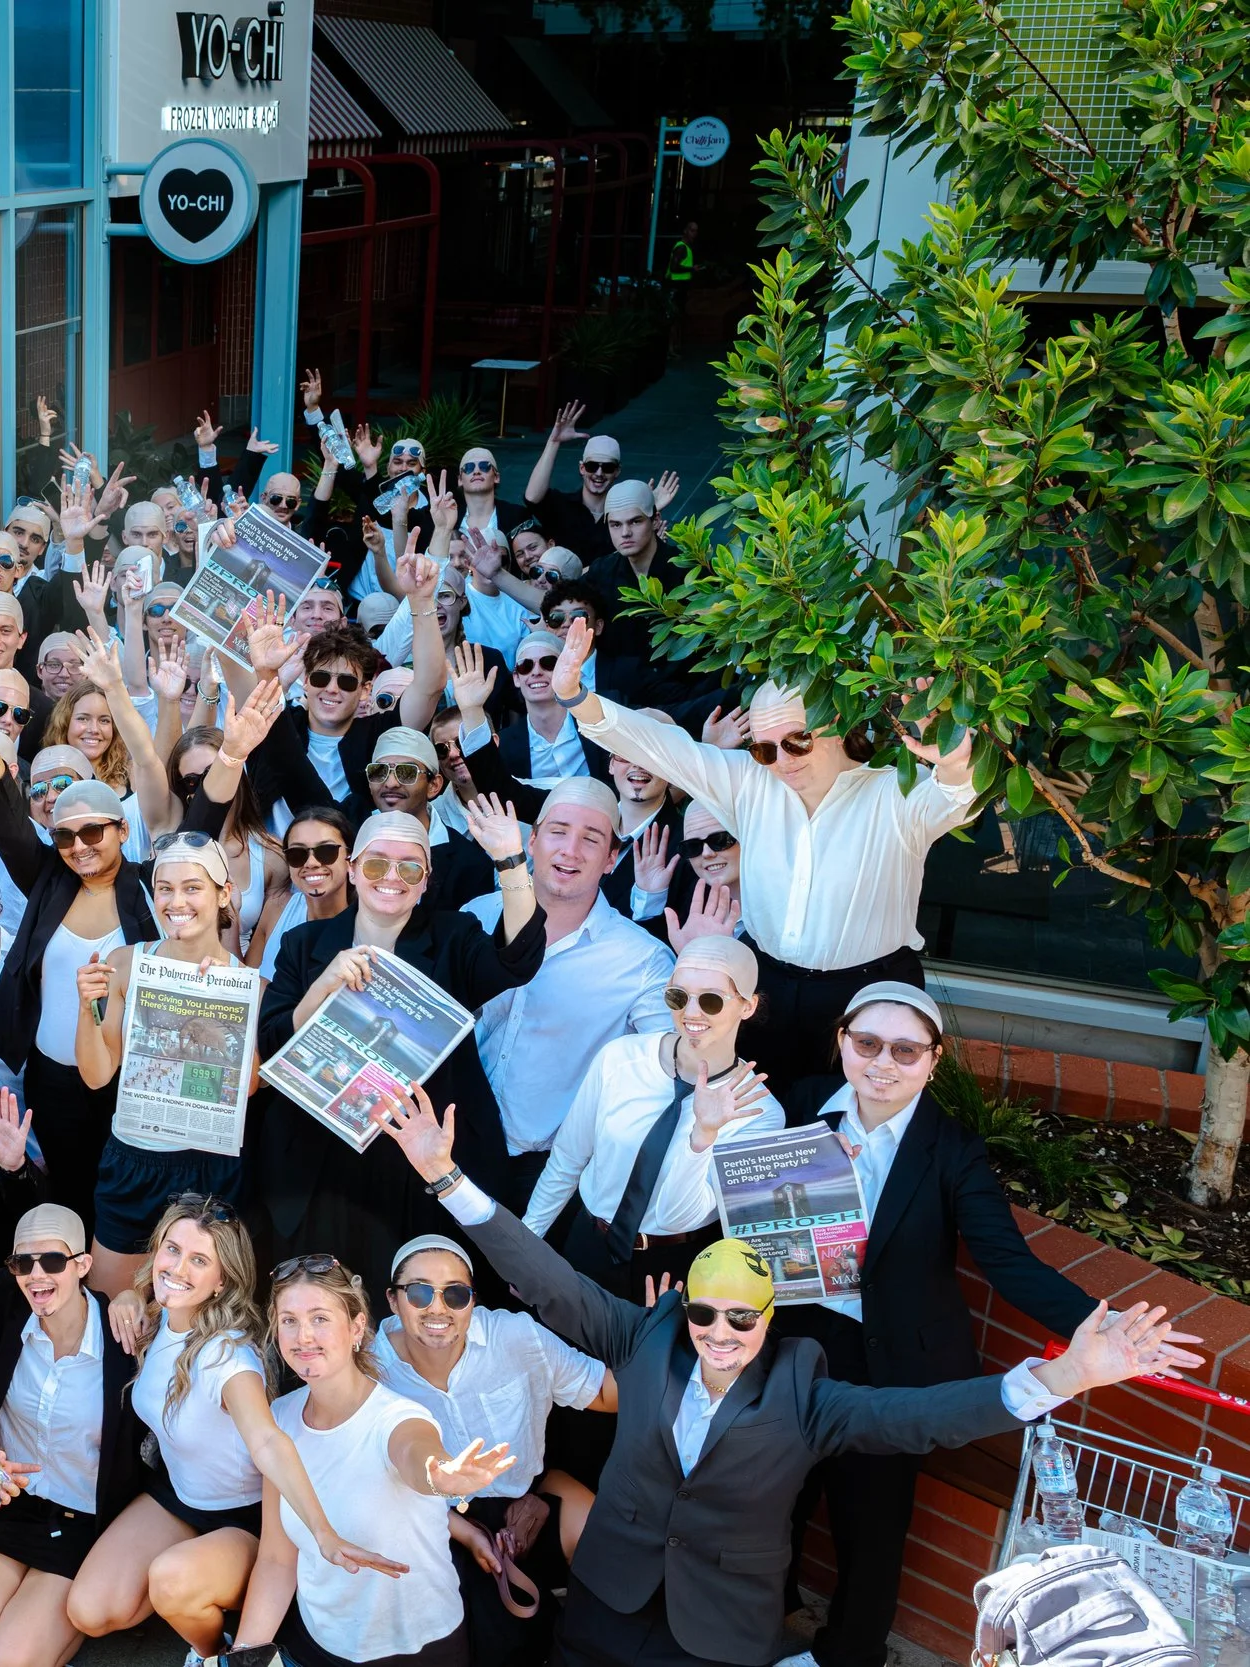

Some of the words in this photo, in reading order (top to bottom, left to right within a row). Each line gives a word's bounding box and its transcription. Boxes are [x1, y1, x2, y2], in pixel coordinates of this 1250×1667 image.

[170, 106, 209, 130] FROZEN
[212, 106, 249, 130] YOGURT
[251, 107, 258, 128] &
[167, 194, 225, 212] YO-CHI
[242, 518, 261, 534] Perth's
[262, 532, 284, 550] Hottest
[284, 548, 299, 560] New
[243, 534, 258, 547] Page
[255, 534, 265, 545] The
[266, 543, 282, 557] Party
[139, 963, 156, 976] The
[159, 966, 204, 983] Polycrisis
[206, 974, 252, 990] Periodical
[140, 991, 156, 999] Life
[158, 994, 183, 1007] Giving
[204, 1002, 244, 1013] Lemons?
[367, 987, 386, 1003] Page
[382, 988, 395, 1001] The
[395, 997, 416, 1016] Party
[391, 985, 418, 1008] Hottest
[417, 1004, 435, 1020] New
[140, 999, 166, 1011] There's
[169, 1005, 195, 1016] Bigger
[197, 1010, 215, 1018] Fish
[217, 1012, 228, 1020] To
[230, 1014, 243, 1023] Fry
[134, 1093, 155, 1101] WORLD
[162, 1098, 184, 1106] ENDING
[192, 1103, 209, 1111] DOHA
[210, 1106, 235, 1115] AIRPORT
[723, 1157, 756, 1169] Perth's
[757, 1151, 794, 1163] Hottest
[795, 1147, 817, 1157] New
[724, 1166, 752, 1178] Club!!
[753, 1163, 772, 1172] The
[773, 1159, 799, 1170] Party
[800, 1156, 810, 1164] is
[741, 1173, 766, 1185] Page
[767, 1171, 777, 1179] 4.
[732, 1210, 861, 1235] #PROSH
[769, 1249, 788, 1257] Long?
[831, 1273, 861, 1286] MAG
